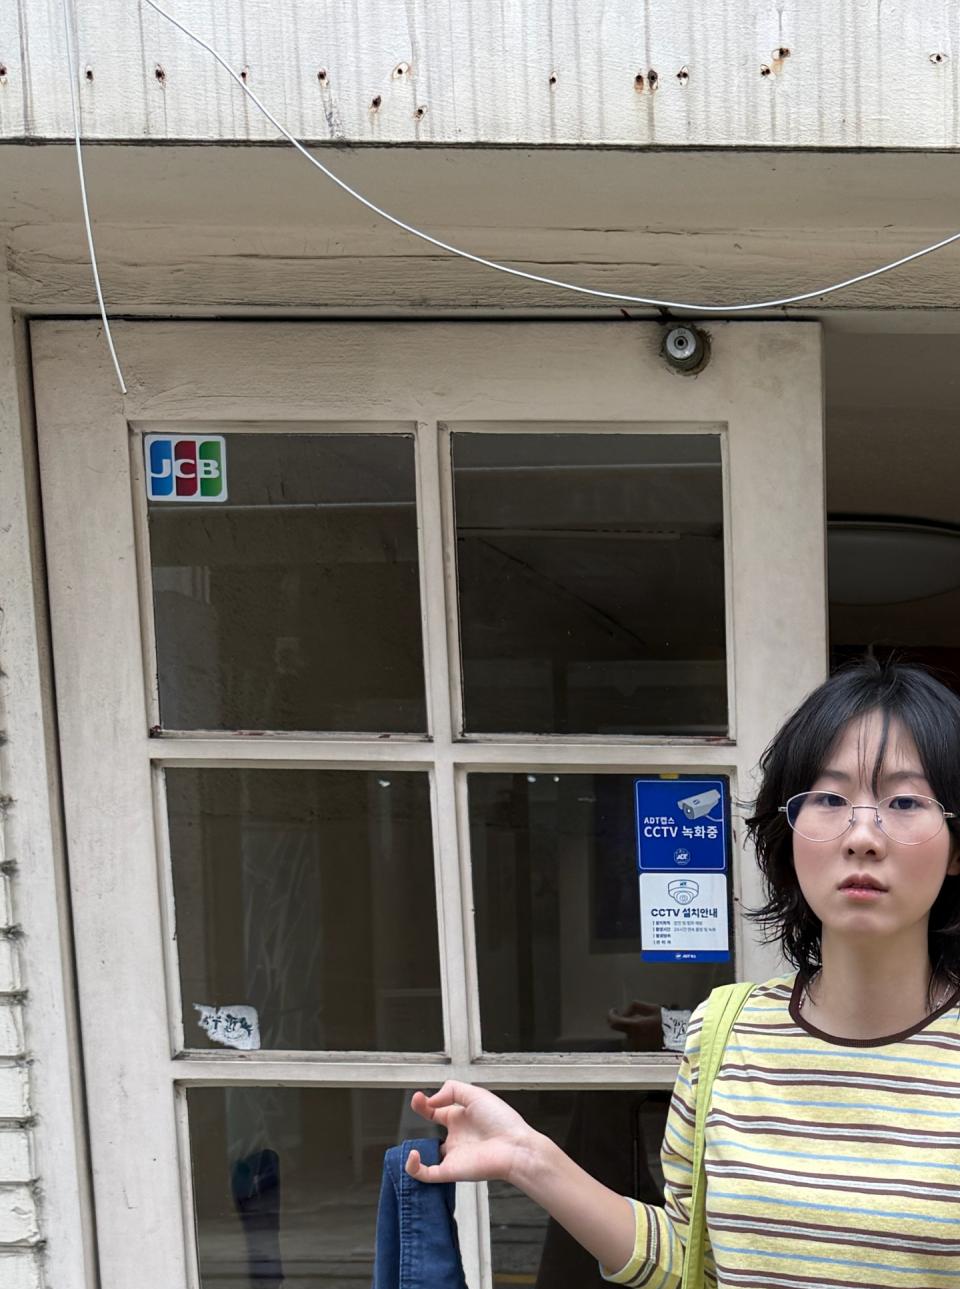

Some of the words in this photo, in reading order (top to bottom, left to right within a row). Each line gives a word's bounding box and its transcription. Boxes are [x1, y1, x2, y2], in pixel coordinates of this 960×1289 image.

[150, 458, 220, 478] JCB
[643, 826, 678, 838] CCTV
[681, 825, 719, 839] 녹화중
[651, 908, 680, 917] CCTV
[682, 907, 718, 918] 설치안내
